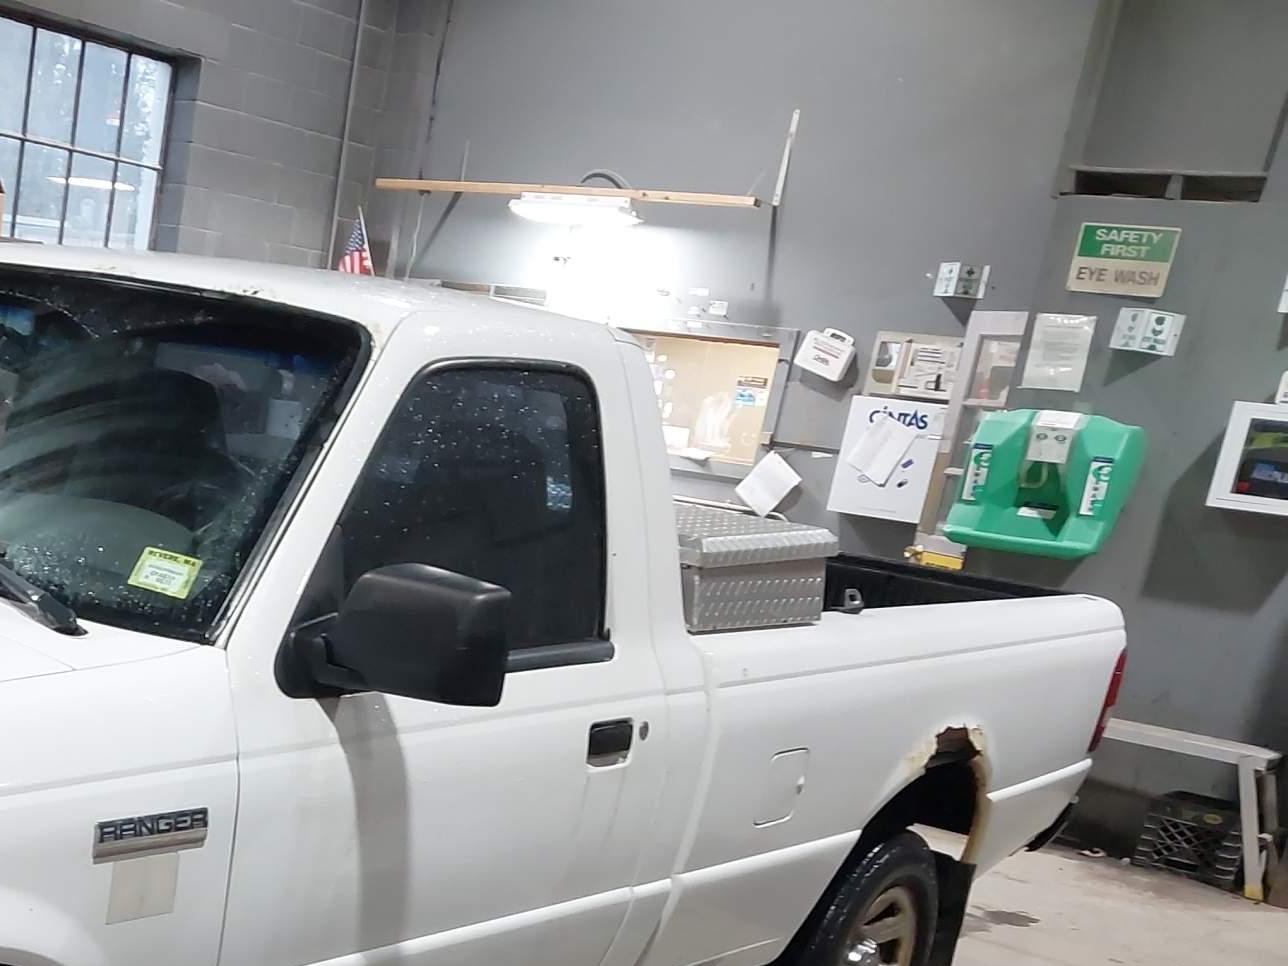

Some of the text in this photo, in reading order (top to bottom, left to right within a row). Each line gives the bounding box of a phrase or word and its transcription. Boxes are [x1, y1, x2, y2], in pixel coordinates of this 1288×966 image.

[1095, 228, 1163, 244] SAFETY
[1100, 243, 1151, 258] FIRST
[1075, 266, 1161, 287] EYE WASH
[98, 809, 208, 843] RANGER
